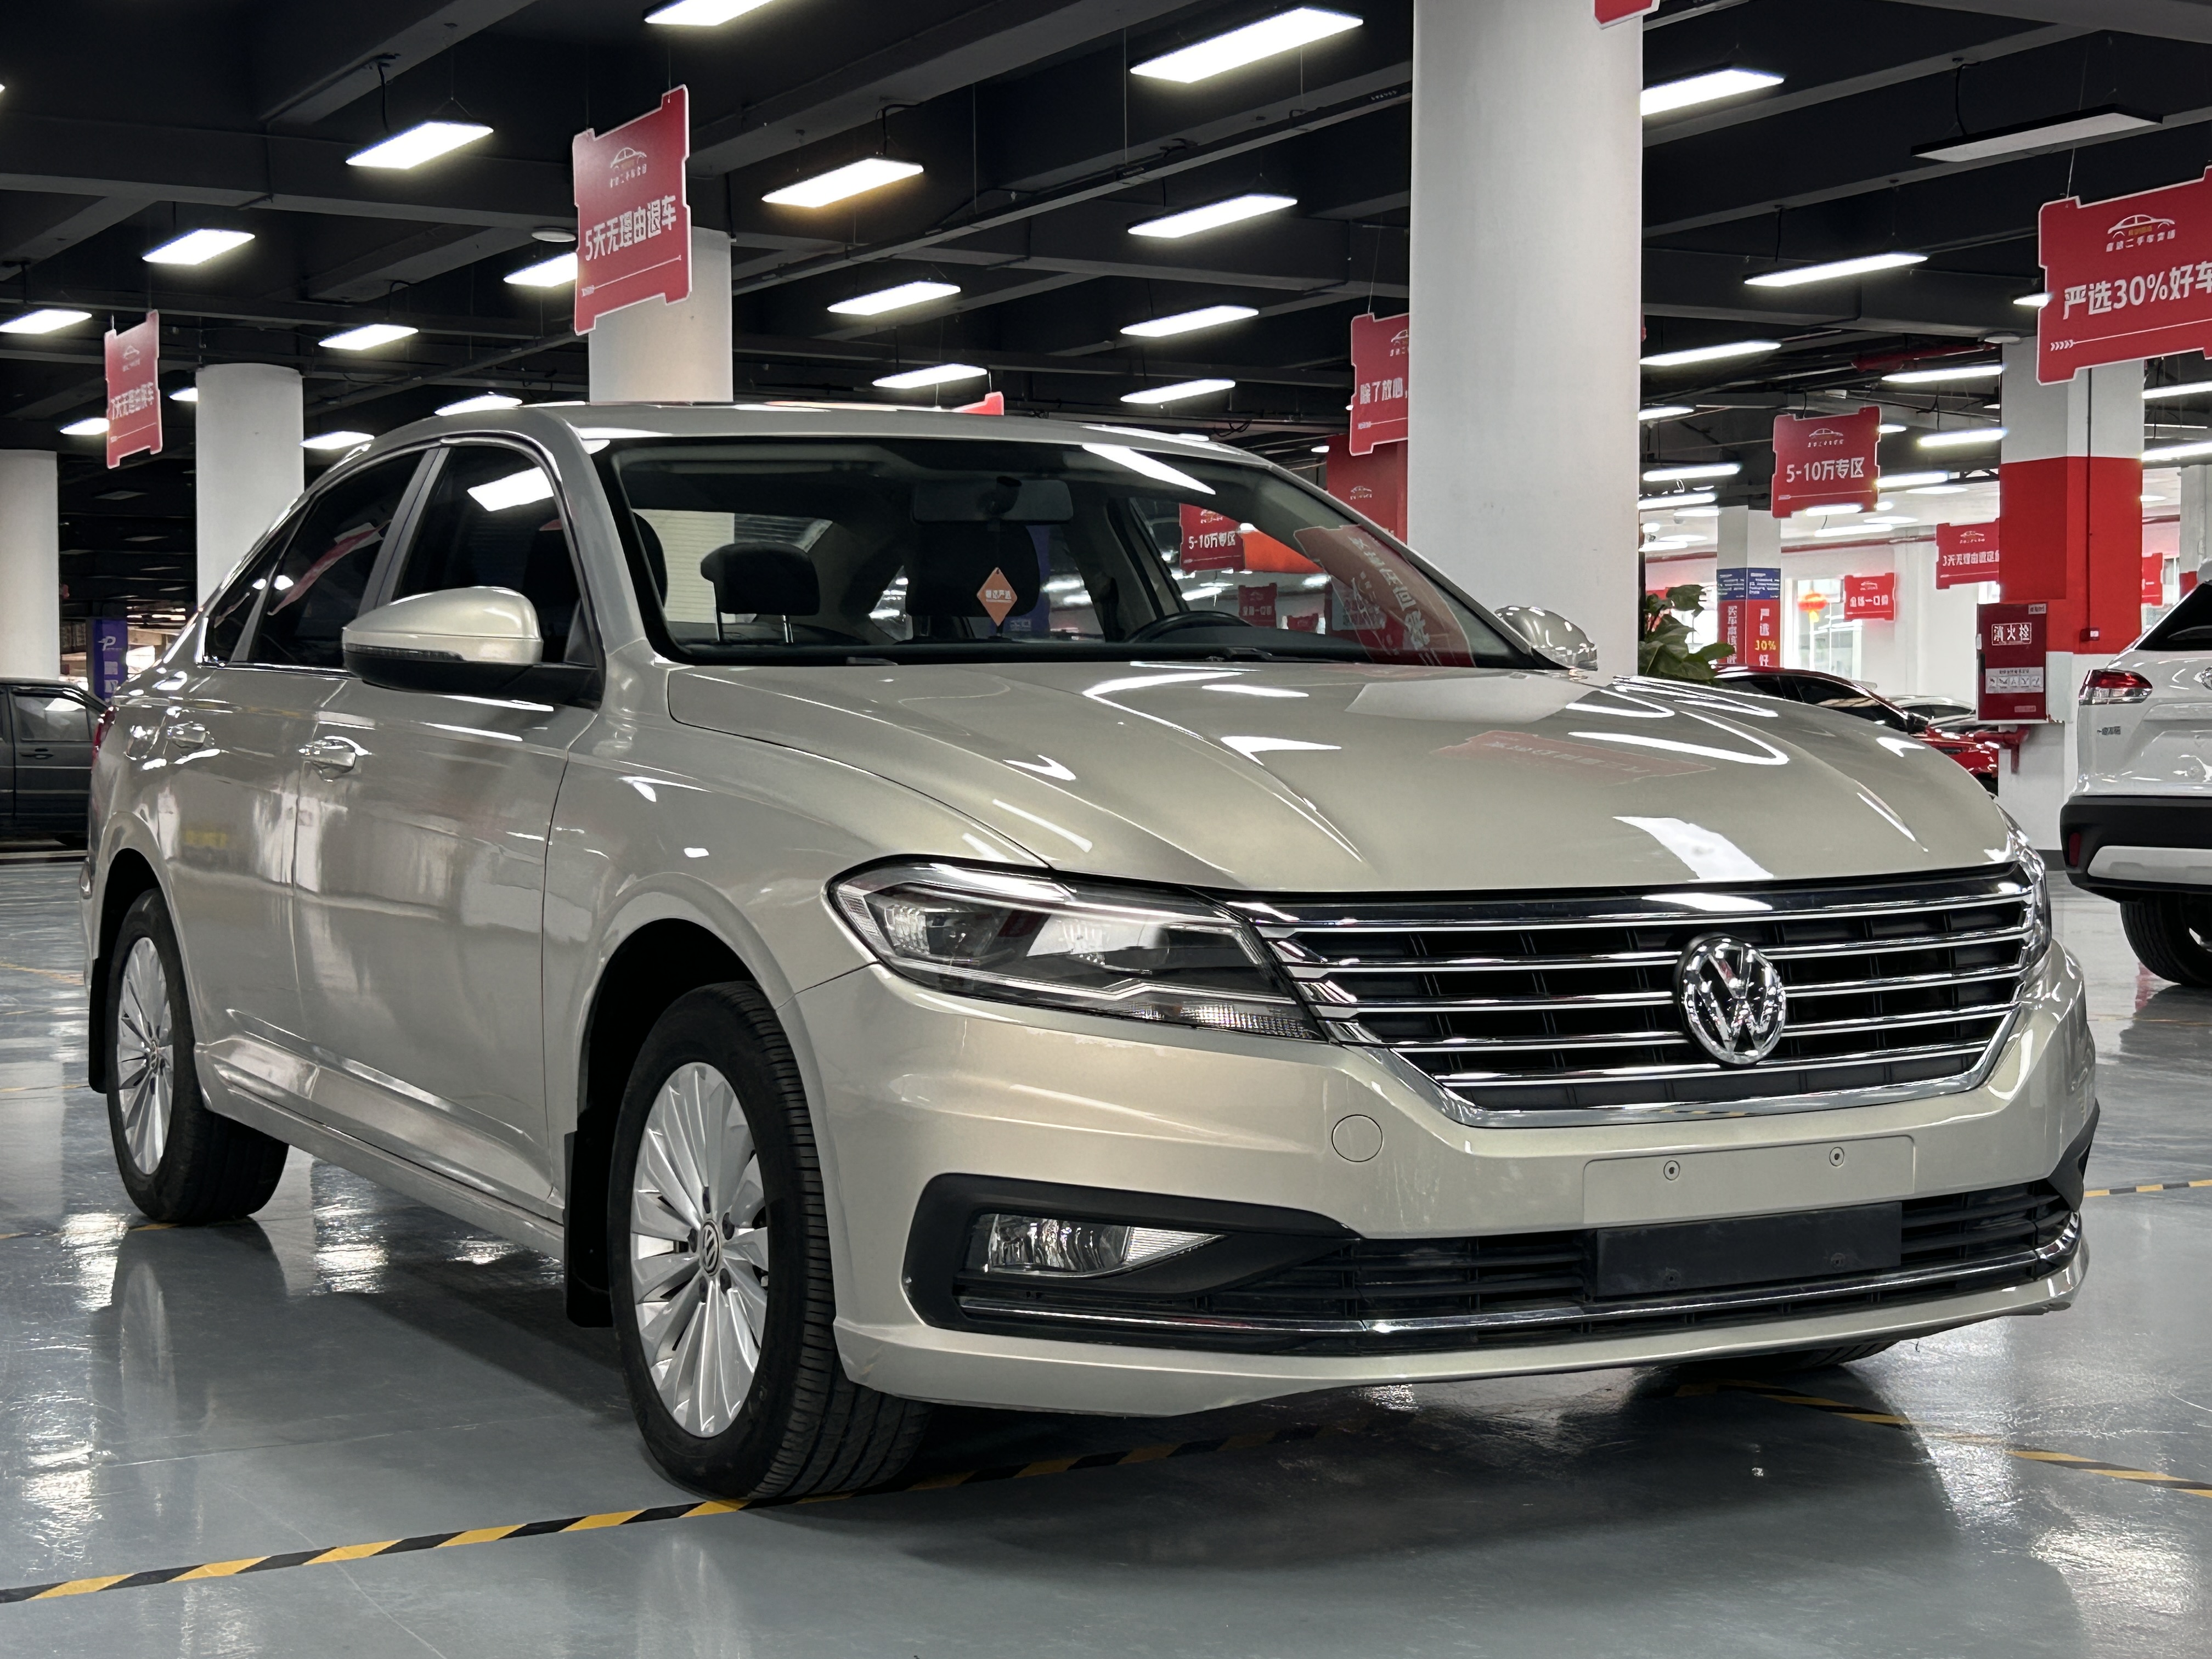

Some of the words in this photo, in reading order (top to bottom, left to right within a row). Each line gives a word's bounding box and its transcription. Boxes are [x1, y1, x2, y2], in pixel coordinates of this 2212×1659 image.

[585, 195, 676, 261] 5天无理由退车
[2063, 260, 2212, 320] 严选30%好车
[1786, 456, 1865, 483] 5-10万专区
